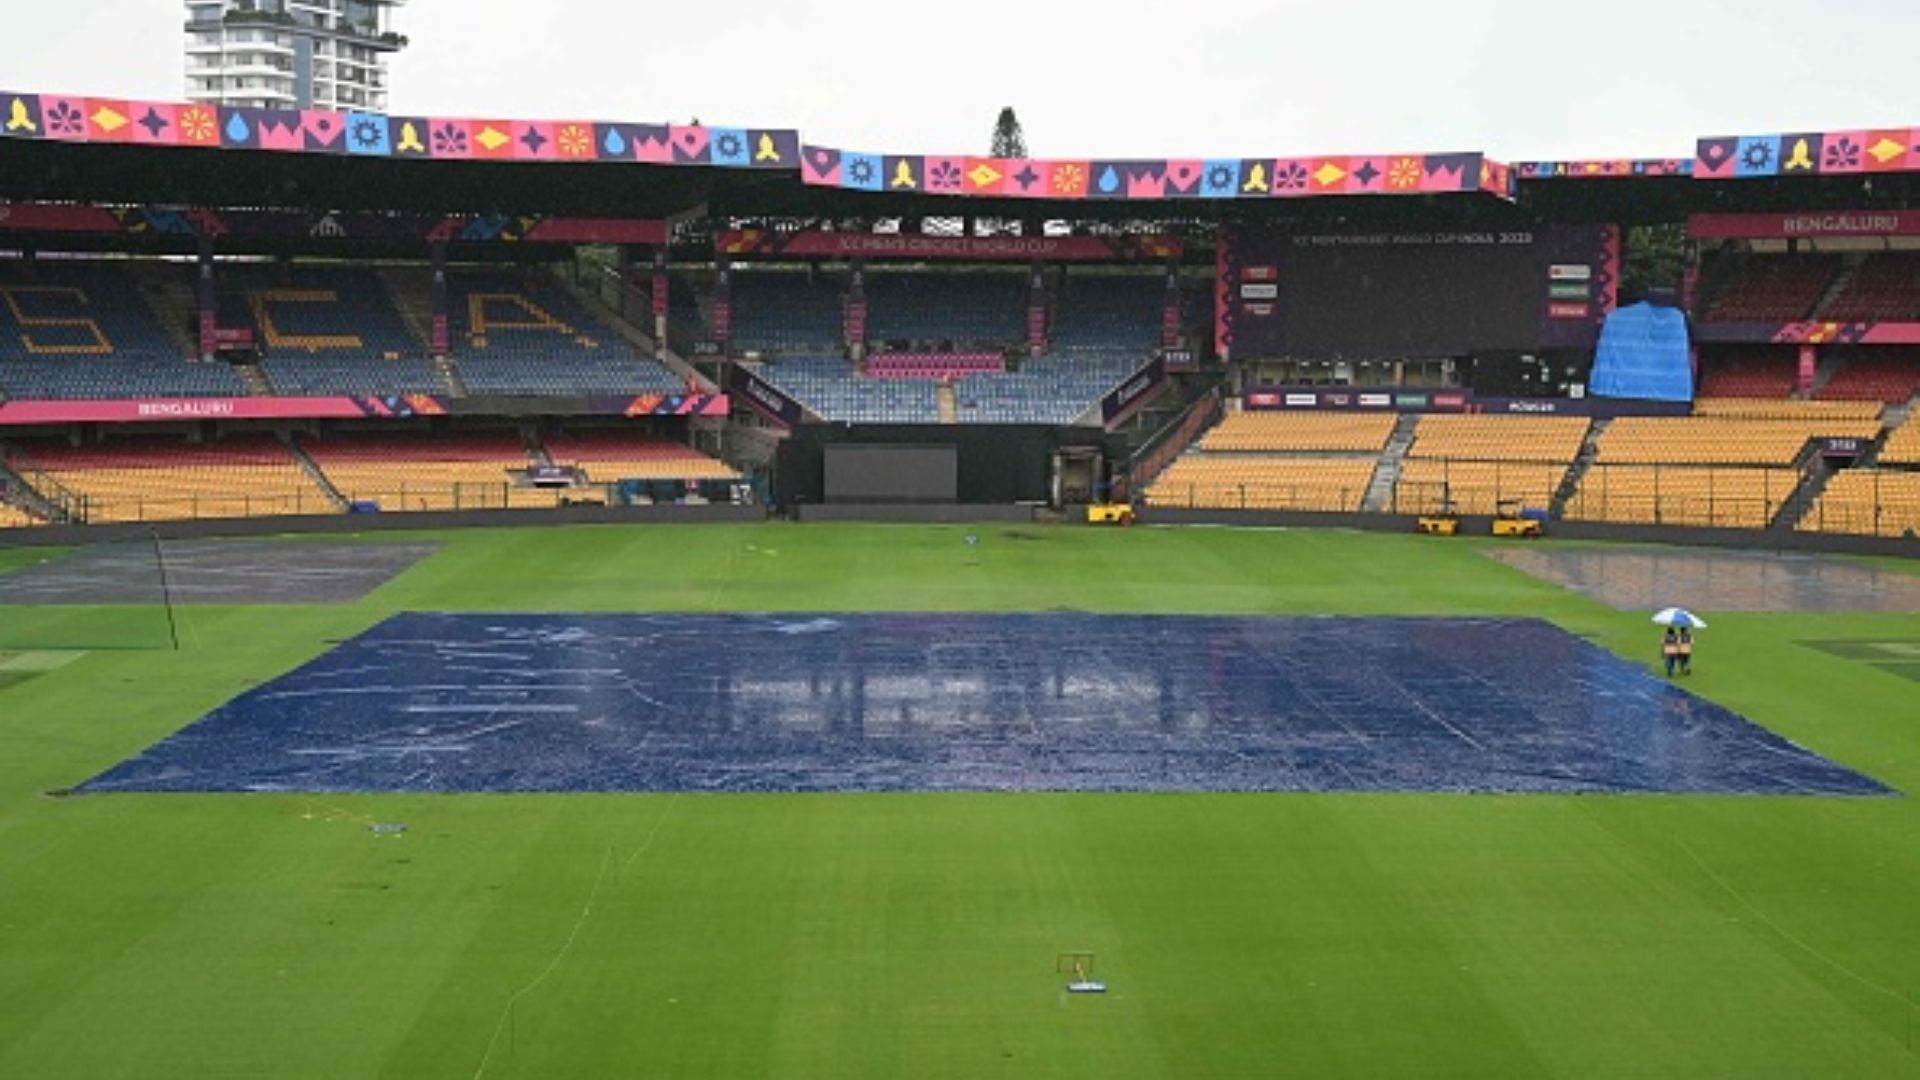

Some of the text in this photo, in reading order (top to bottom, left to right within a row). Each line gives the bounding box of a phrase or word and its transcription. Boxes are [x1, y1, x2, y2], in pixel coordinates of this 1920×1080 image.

[1783, 215, 1899, 233] BENGALURU
[908, 238, 968, 252] CRICKET
[972, 239, 1025, 253] WORLD
[1027, 239, 1058, 252] CUP
[1458, 232, 1495, 244] INDIA
[1499, 232, 1533, 244] 2023
[138, 400, 234, 415] BENGALURU
